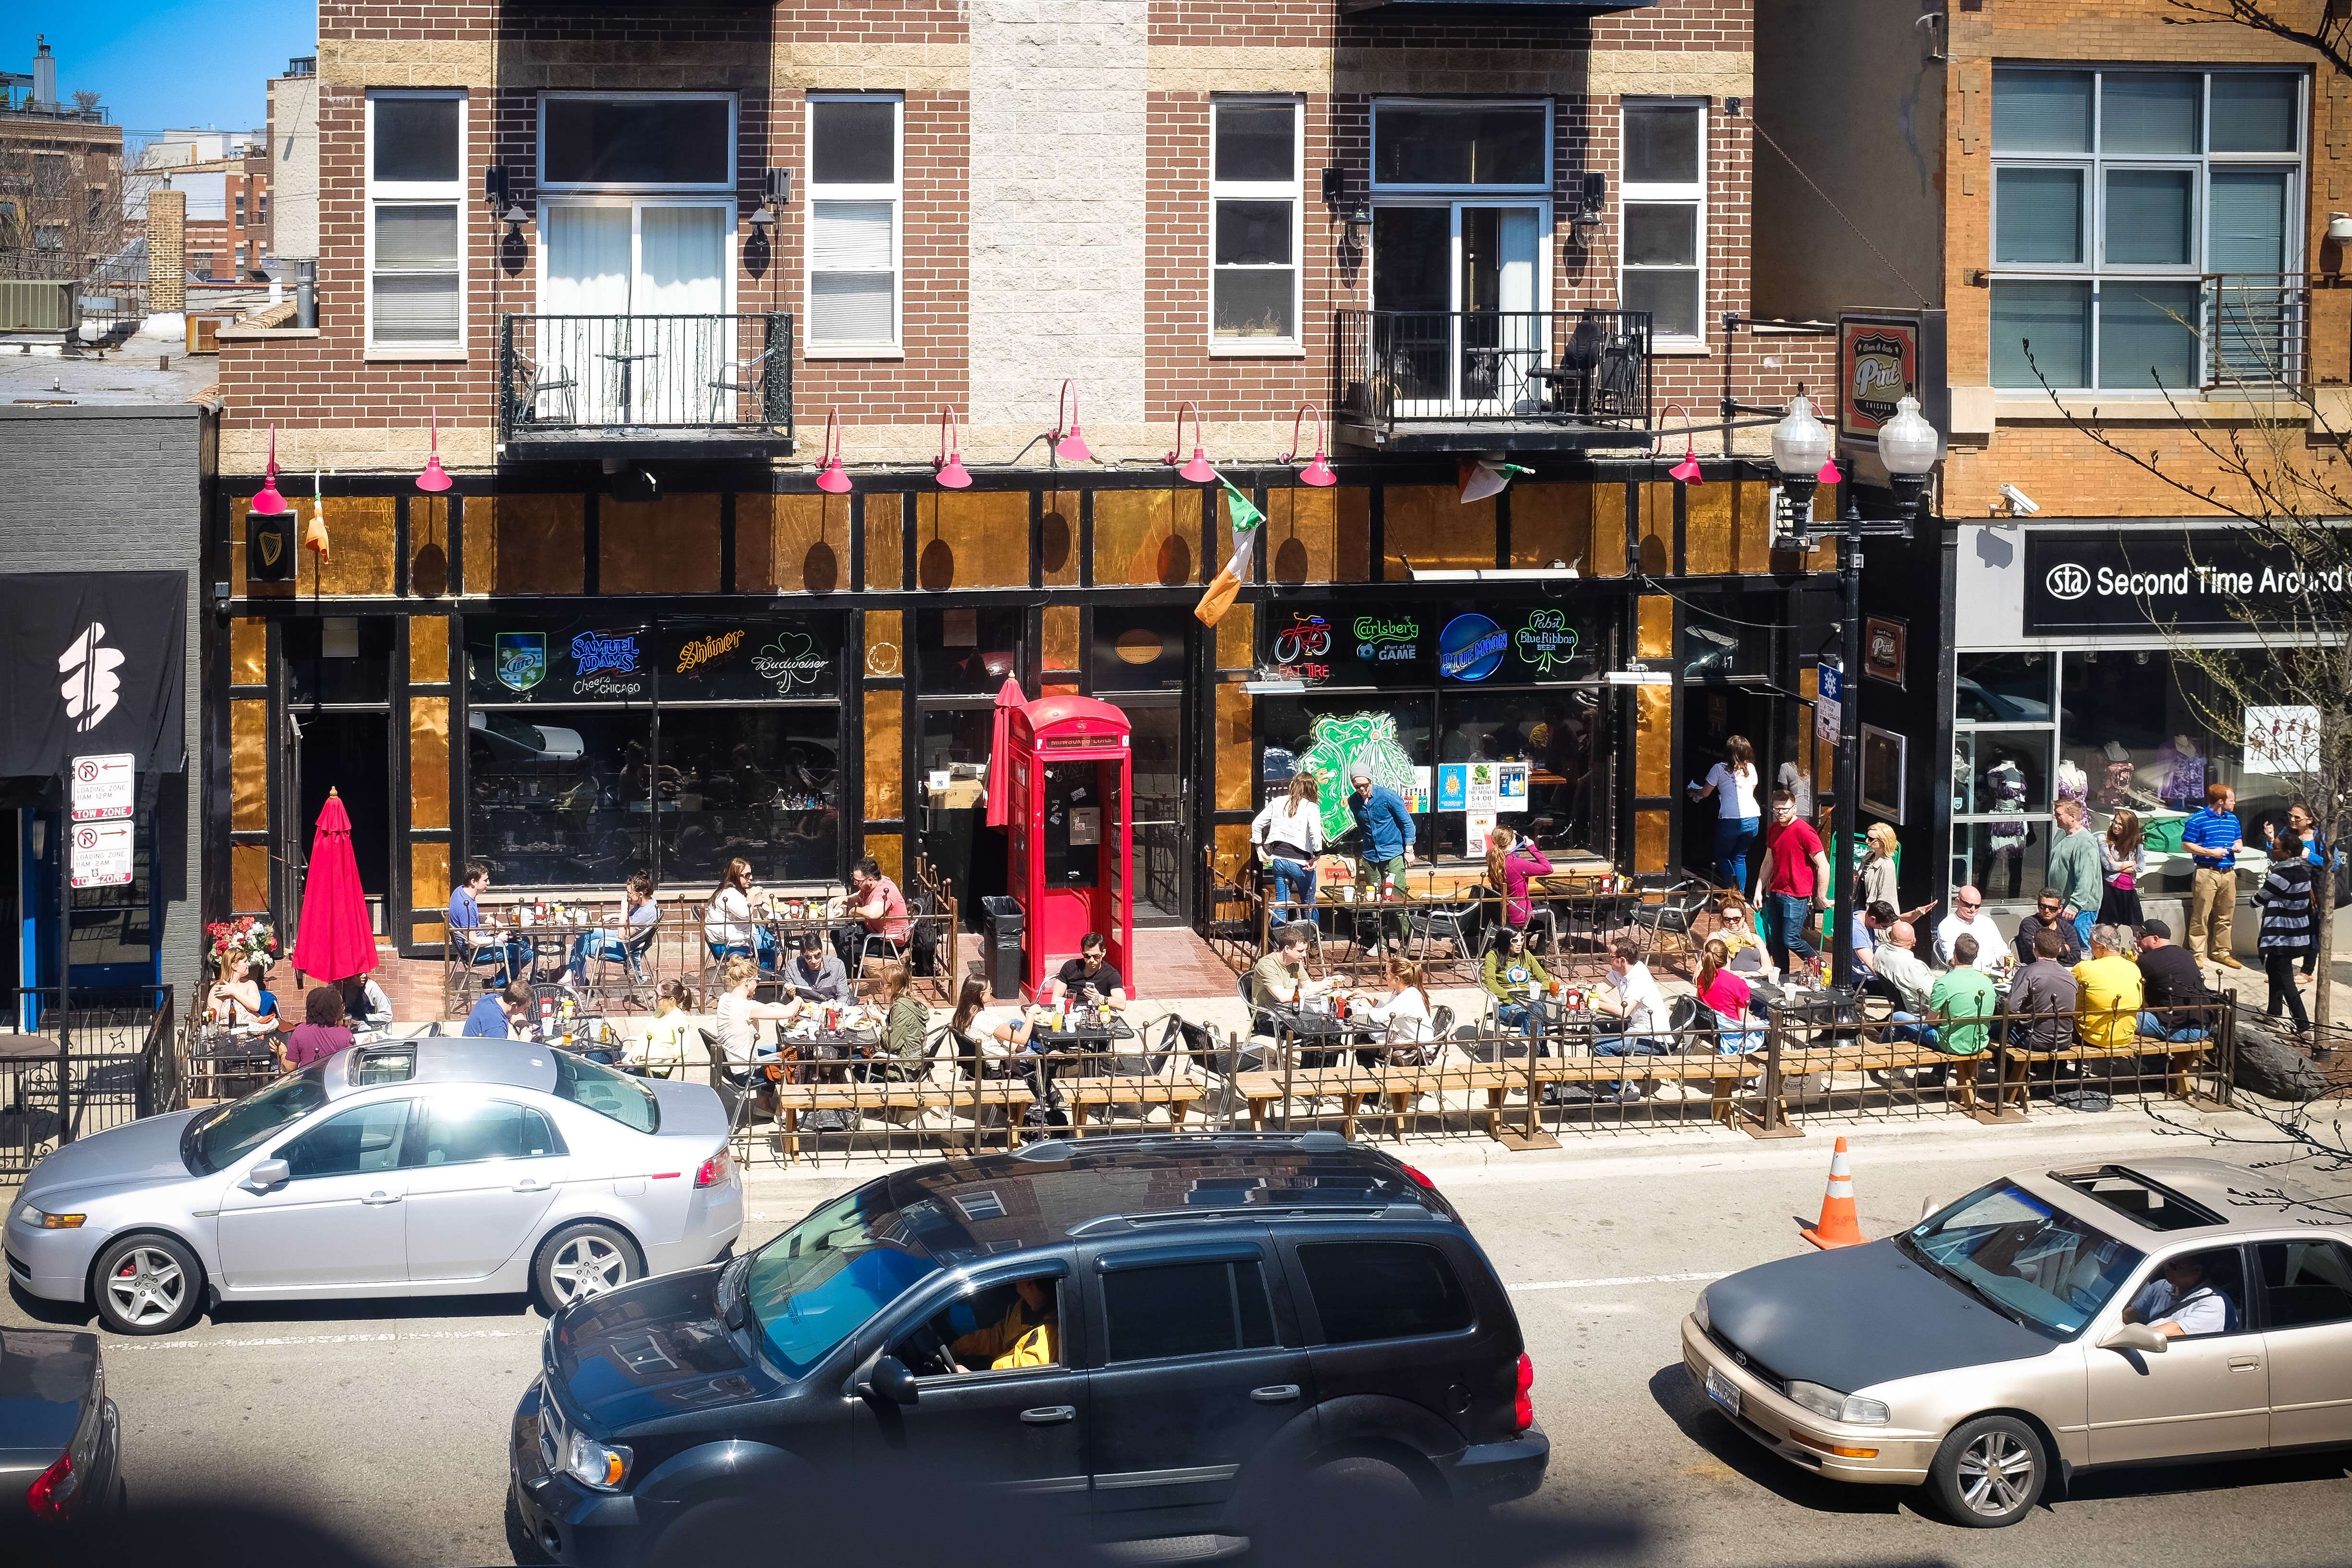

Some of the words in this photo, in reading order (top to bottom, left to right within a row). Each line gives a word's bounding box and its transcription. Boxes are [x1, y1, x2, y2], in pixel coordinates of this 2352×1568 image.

[1856, 359, 1900, 396] Pint
[1866, 402, 1891, 411] CHICAGO
[2054, 566, 2083, 593] sta
[2097, 566, 2188, 596] Second
[2195, 565, 2253, 594] Time
[1353, 616, 1419, 640] Carlsberg
[1533, 612, 1562, 629] Pabst
[1520, 631, 1541, 643] Blue
[1541, 632, 1575, 644] Ribbon
[572, 637, 639, 659] SAMUEL
[677, 630, 745, 673] Shiner
[1378, 649, 1416, 661] GAME
[1440, 648, 1475, 677] BLUE
[1474, 633, 1507, 661] MOON
[1872, 638, 1895, 655] Pint
[576, 653, 635, 675] ADAMS
[751, 657, 829, 671] Budweiser
[1278, 663, 1301, 677] FAT
[573, 676, 611, 694] Cheers
[600, 683, 641, 694] CHICAGO
[77, 809, 97, 819] TOW
[101, 807, 127, 817] ZONE
[76, 853, 104, 861] LOADING
